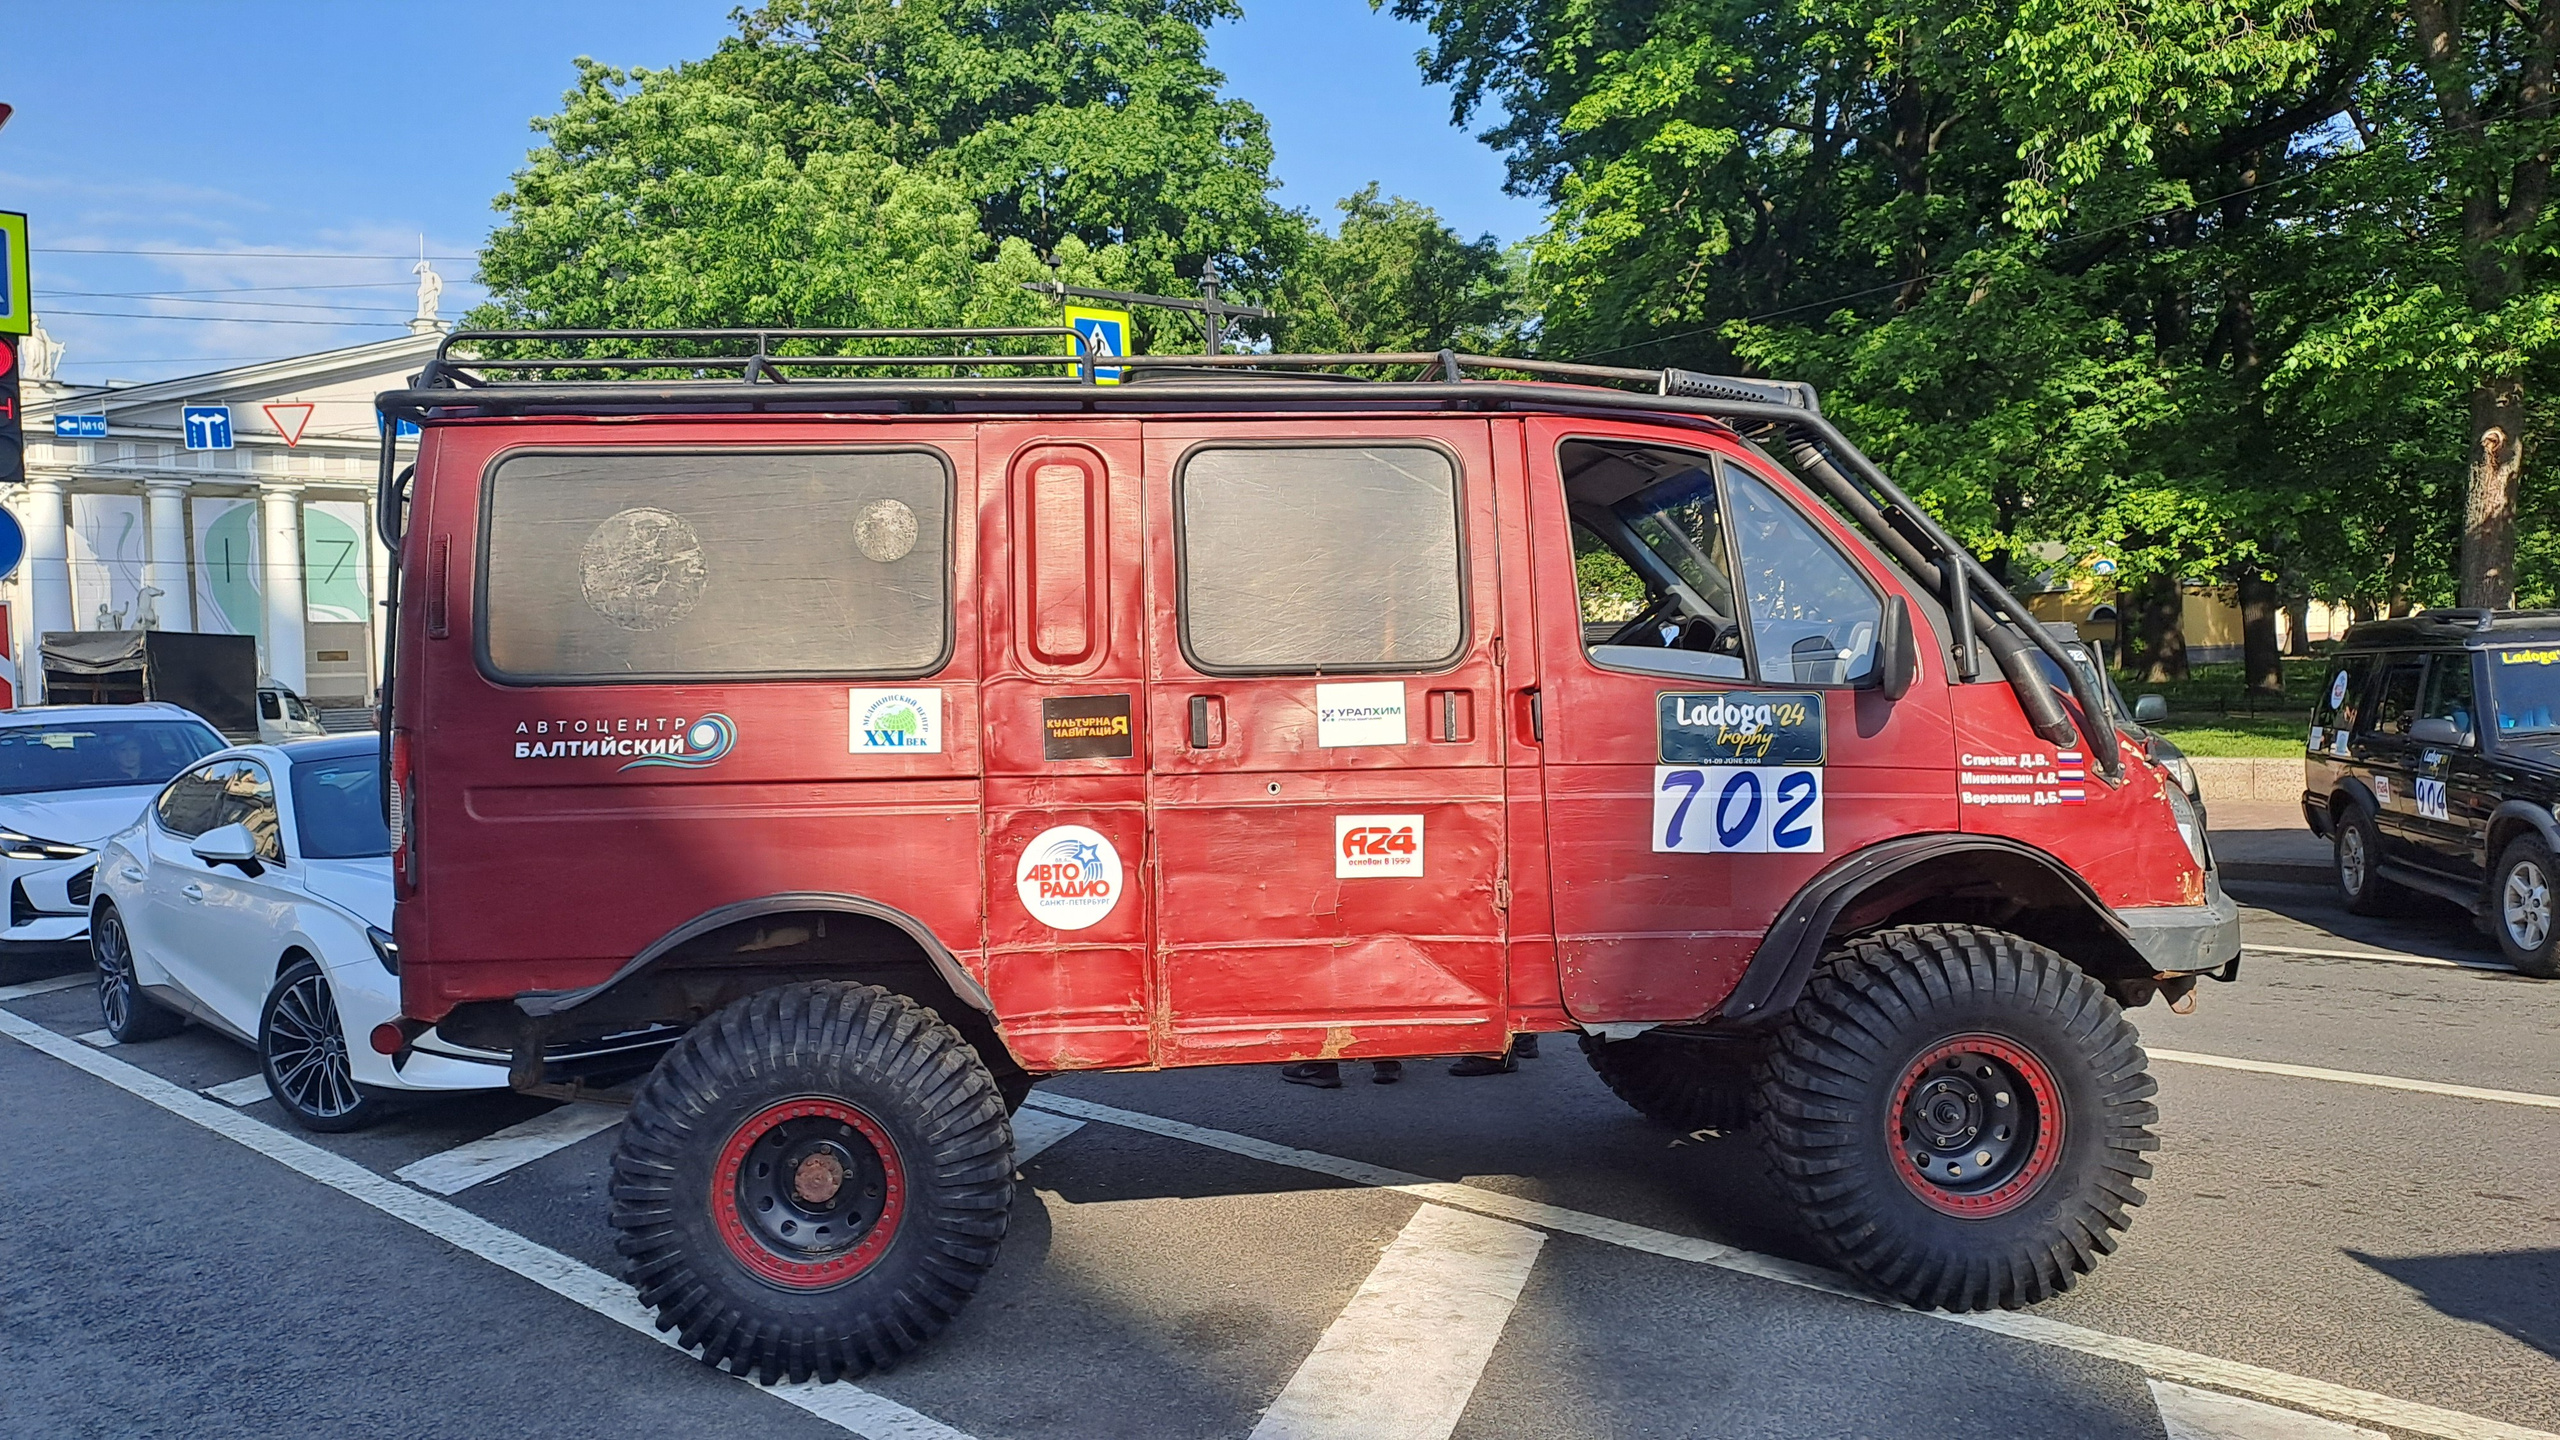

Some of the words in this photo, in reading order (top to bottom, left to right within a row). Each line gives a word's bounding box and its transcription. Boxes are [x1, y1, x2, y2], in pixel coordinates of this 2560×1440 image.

[1338, 706, 1401, 717] УРАЛХИМ
[515, 718, 686, 734] АВТОЦЕНТР
[514, 734, 685, 759] БАЛТИЙСКИЙ
[906, 738, 928, 746] ВЕК
[1724, 757, 1743, 765] JUNE
[1744, 757, 1762, 765] 2024
[1961, 753, 2017, 766] Спичак
[2019, 753, 2050, 768] Д.В.
[1961, 771, 2033, 785] Мишенькин
[2036, 771, 2060, 785] А.В.
[1961, 791, 2031, 807] Веревкин
[2033, 791, 2063, 806] Д.Б.
[1661, 769, 1817, 849] 702
[1391, 857, 1411, 865] 1999
[1023, 863, 1080, 882] АВТО
[1039, 880, 1110, 899] РАДИО
[1039, 898, 1110, 908] САНКТ-ПЕТЕРБУРГ
